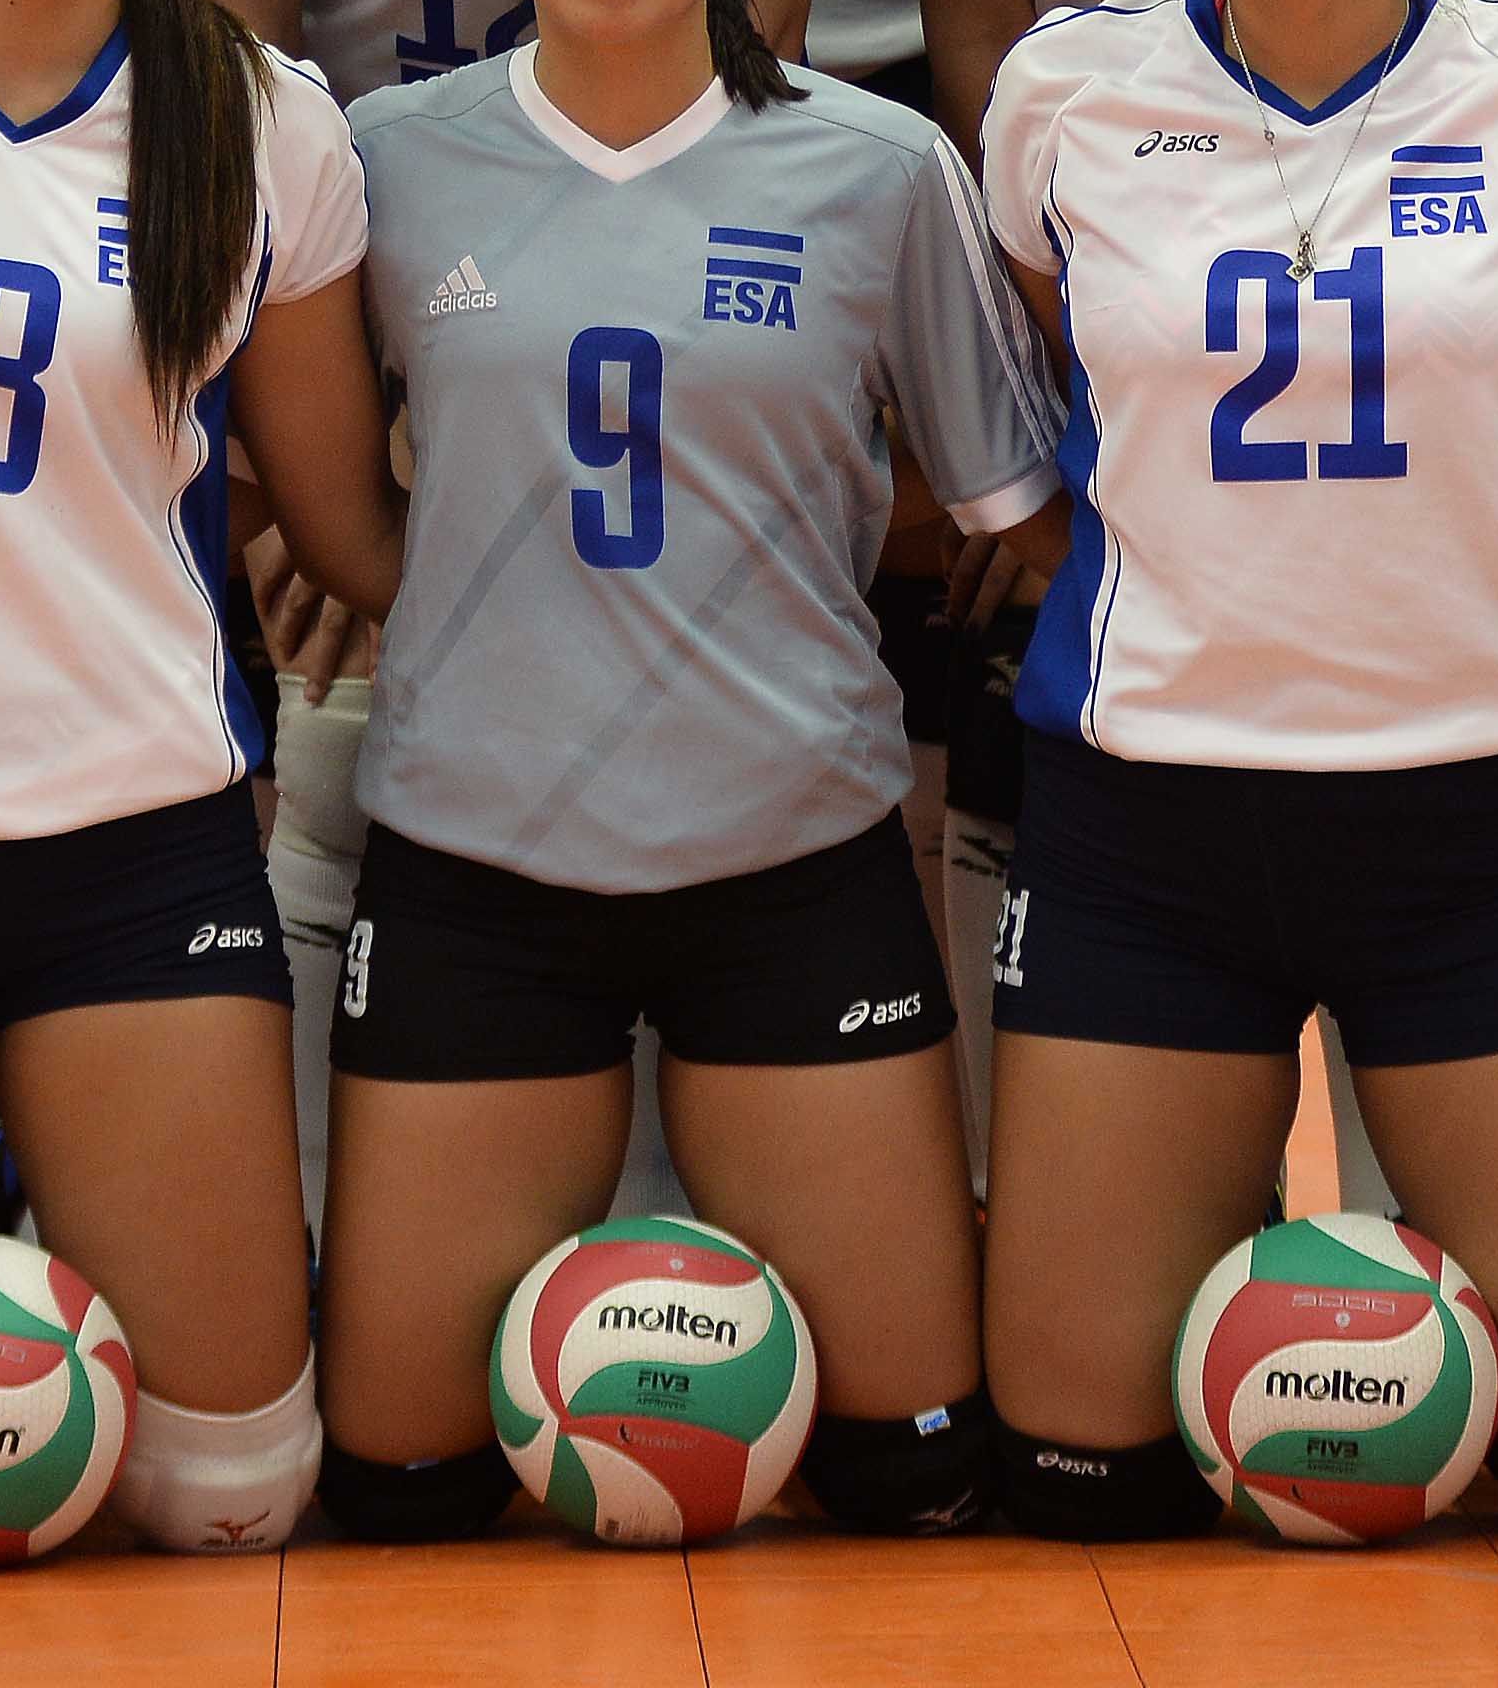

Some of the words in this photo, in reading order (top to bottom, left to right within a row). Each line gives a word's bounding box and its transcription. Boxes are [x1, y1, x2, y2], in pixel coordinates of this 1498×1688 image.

[1162, 133, 1220, 155] asics
[1389, 197, 1488, 238] ESA
[428, 289, 498, 315] adidas
[702, 277, 799, 332] ESA
[1204, 245, 1409, 483] 21
[565, 325, 665, 570] 9
[217, 927, 264, 950] asics
[344, 919, 374, 1019] 9
[872, 991, 922, 1025] asics
[598, 1304, 738, 1348] molten
[637, 1370, 690, 1393] FIVB
[1265, 1370, 1406, 1407] molten
